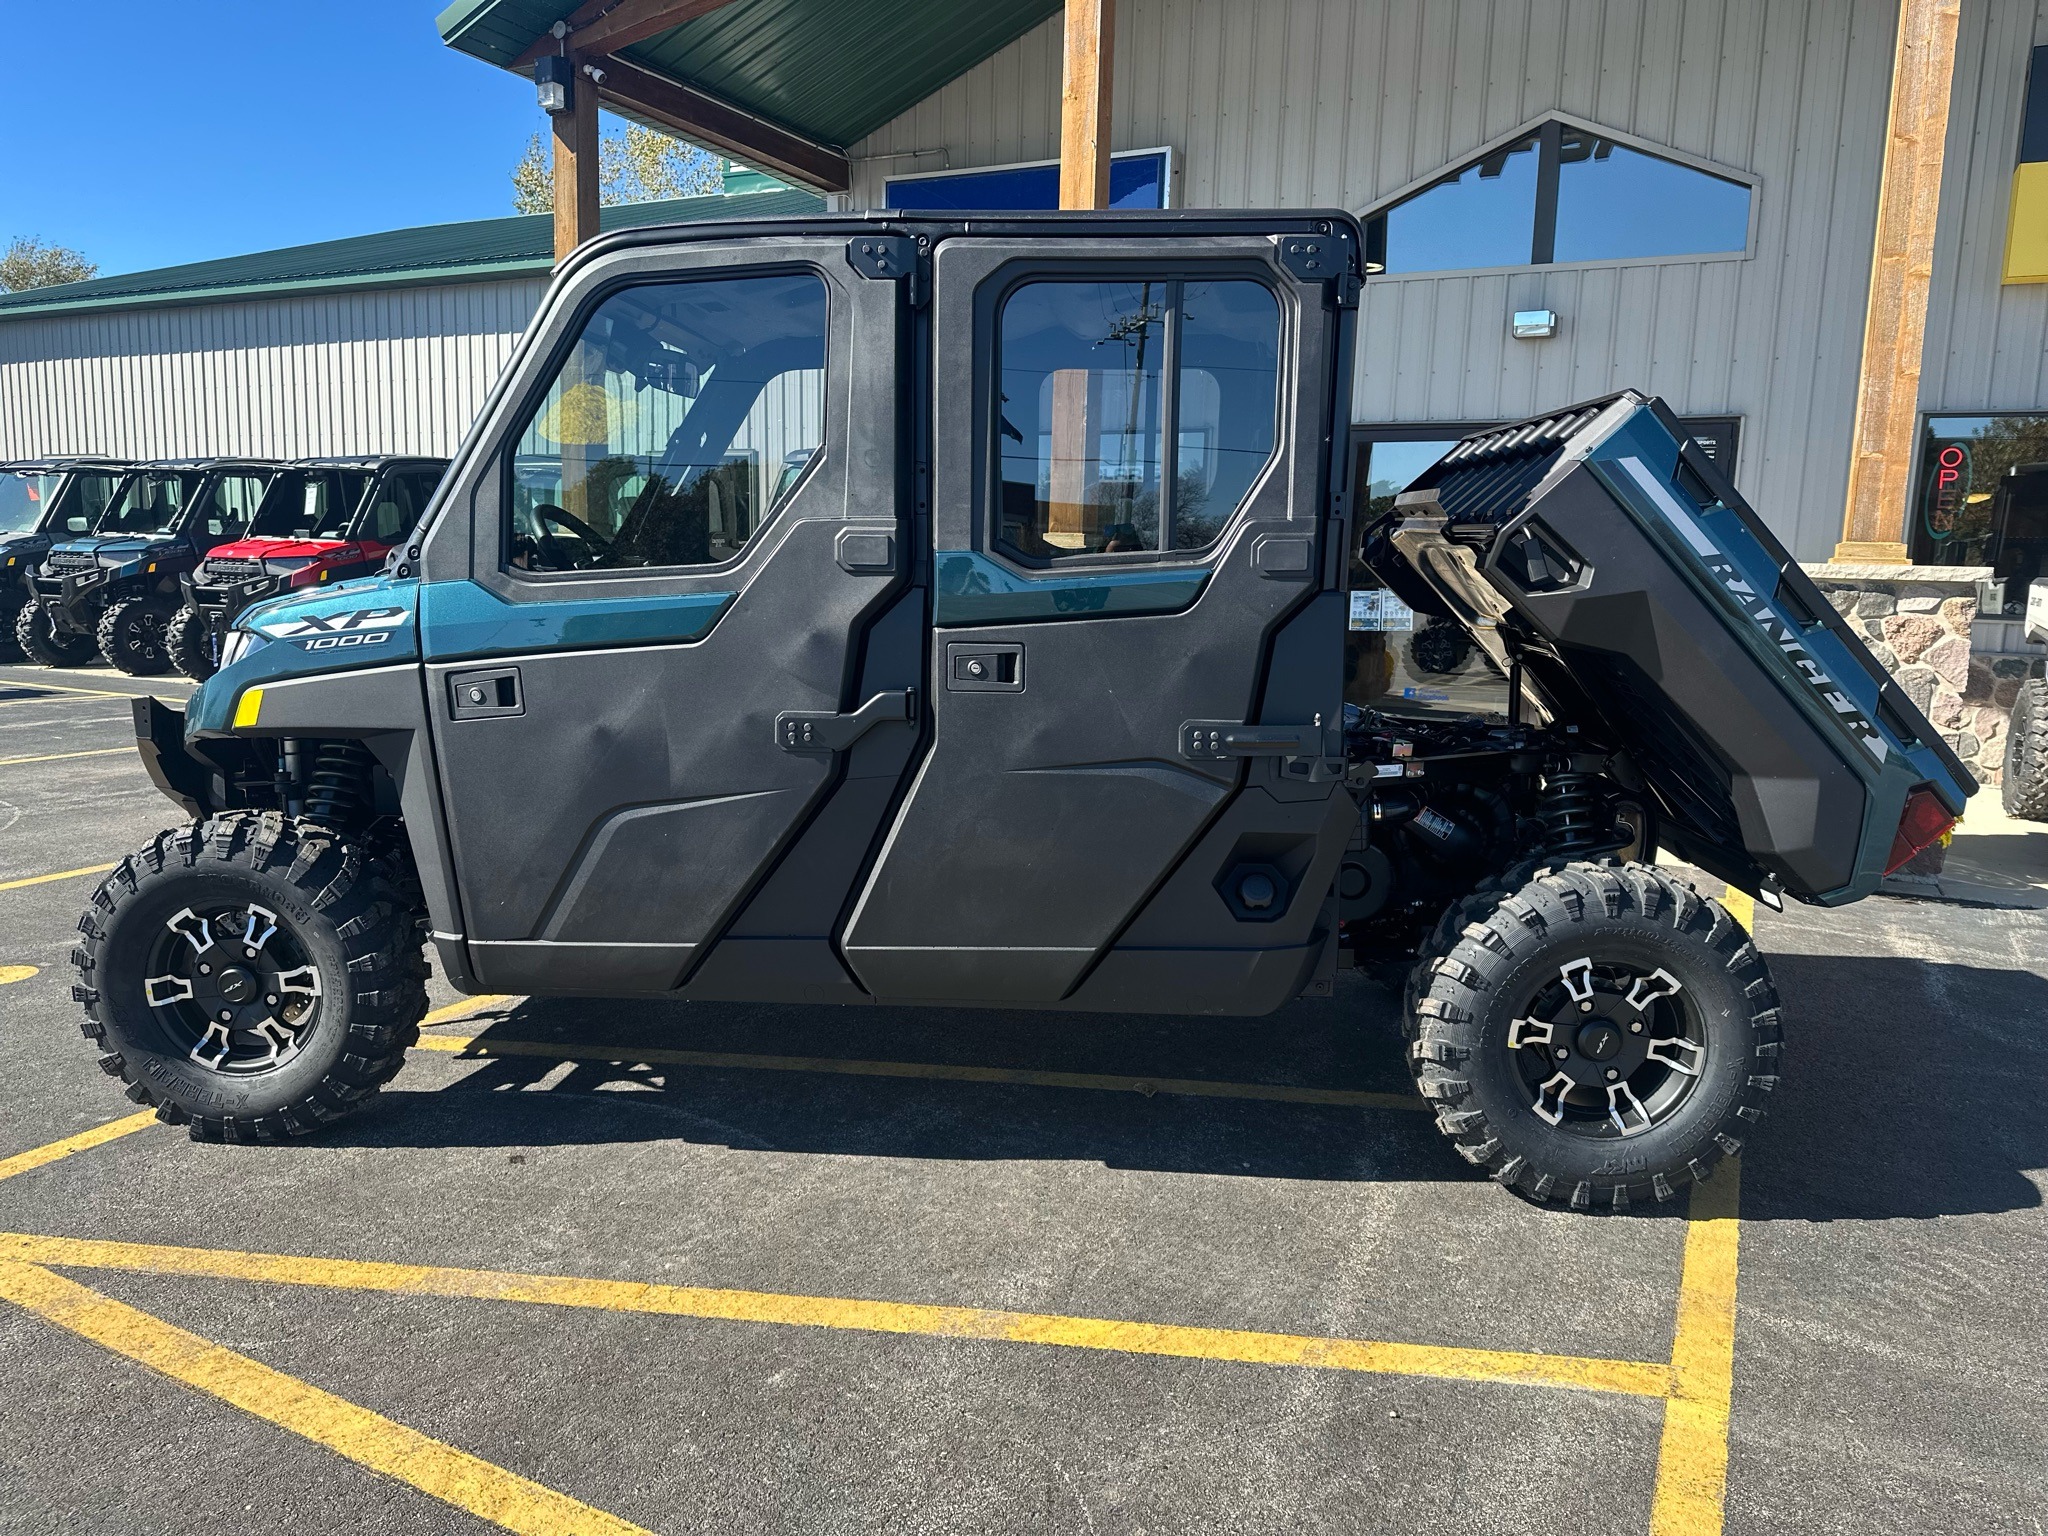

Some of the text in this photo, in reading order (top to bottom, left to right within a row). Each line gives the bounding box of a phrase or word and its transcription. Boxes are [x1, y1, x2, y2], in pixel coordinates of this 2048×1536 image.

[1935, 447, 1963, 531] OPEN
[283, 606, 406, 636] XP
[305, 632, 389, 650] 1000
[1701, 554, 1881, 741] RANGER
[142, 1056, 250, 1109] X-TERRAIN
